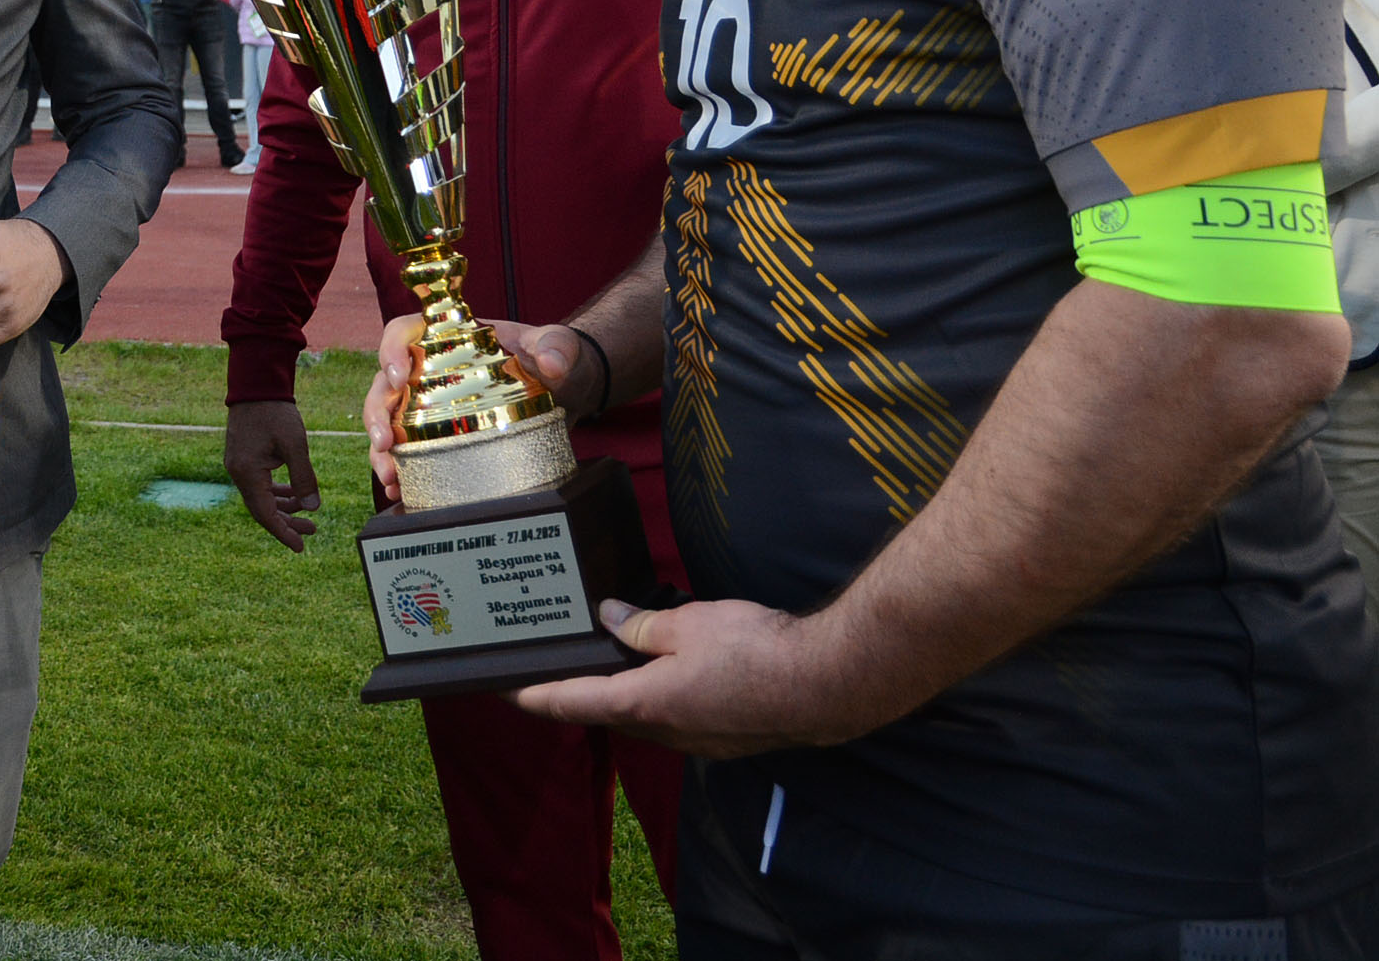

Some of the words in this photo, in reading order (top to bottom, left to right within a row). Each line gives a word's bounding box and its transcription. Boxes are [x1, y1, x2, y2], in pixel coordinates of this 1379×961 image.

[373, 540, 454, 563] БЛАГОТВОРИТЕЛНО
[457, 533, 497, 552] СЪБИТИЕ
[507, 525, 561, 544] 27.04.2025
[476, 553, 543, 570] Звездите
[544, 550, 561, 561] на
[390, 567, 444, 589] НАЦИОНАЛИ
[479, 568, 544, 584] България
[520, 584, 530, 594] и
[486, 597, 553, 614] Звездите
[554, 594, 572, 605] на
[386, 590, 419, 639] ФОНДАЦИЯ
[494, 609, 571, 627] Македония
